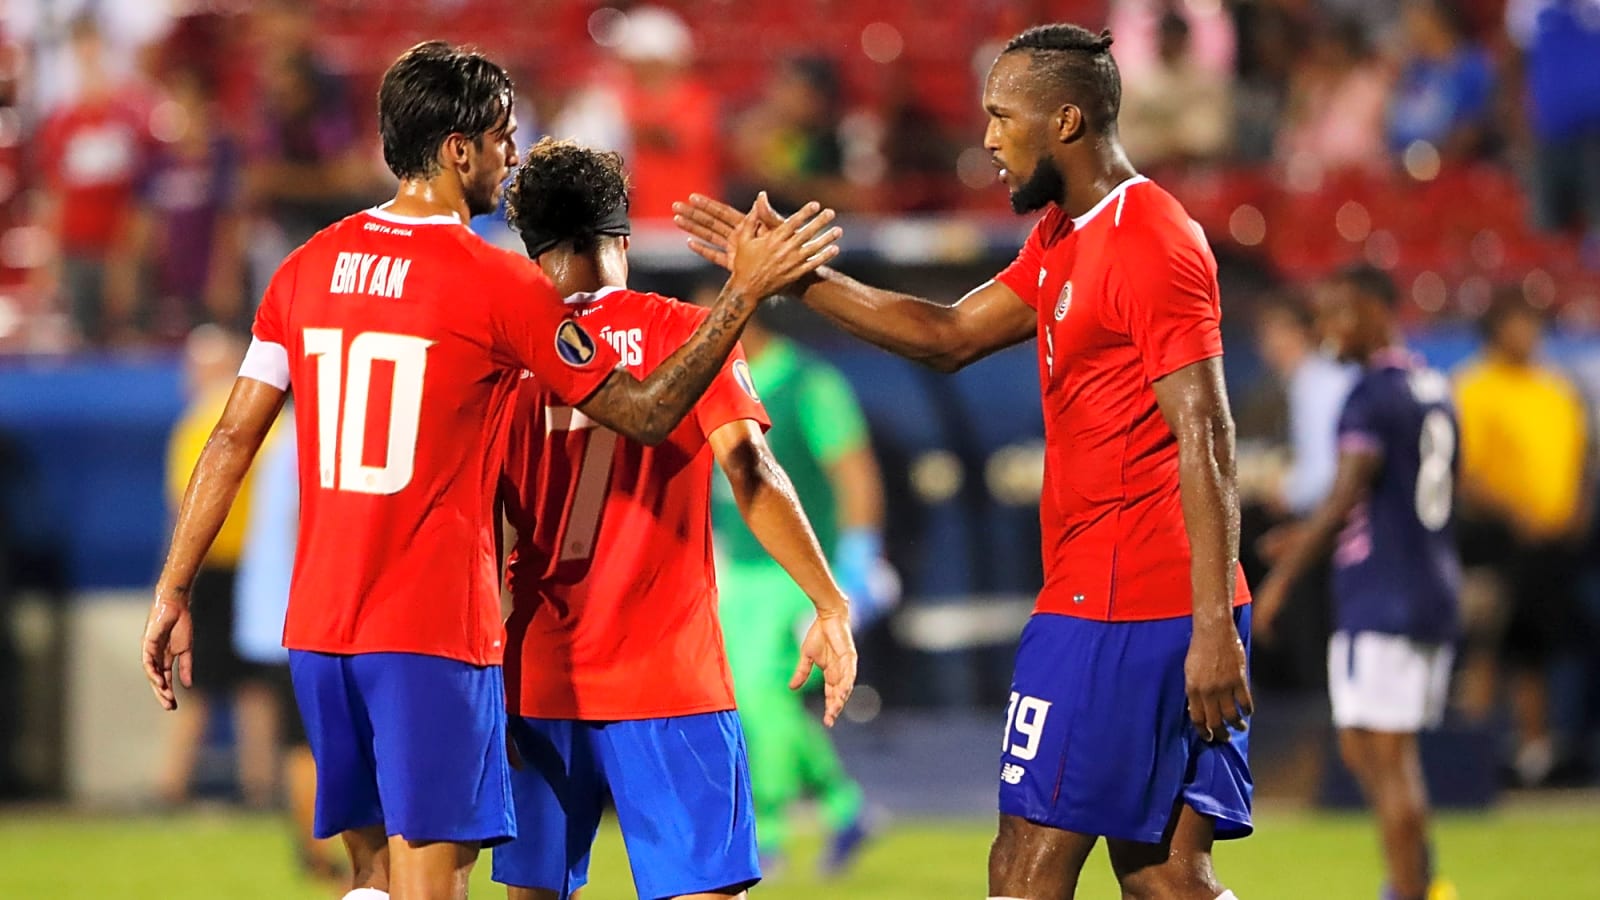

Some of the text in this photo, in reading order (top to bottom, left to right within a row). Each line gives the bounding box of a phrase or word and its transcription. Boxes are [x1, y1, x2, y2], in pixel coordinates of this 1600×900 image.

[330, 251, 412, 299] BRYAN
[363, 221, 413, 237] COSTA RICA
[302, 327, 439, 496] 10
[545, 405, 617, 561] 7
[1415, 408, 1455, 532] 8
[1002, 691, 1053, 761] 19
